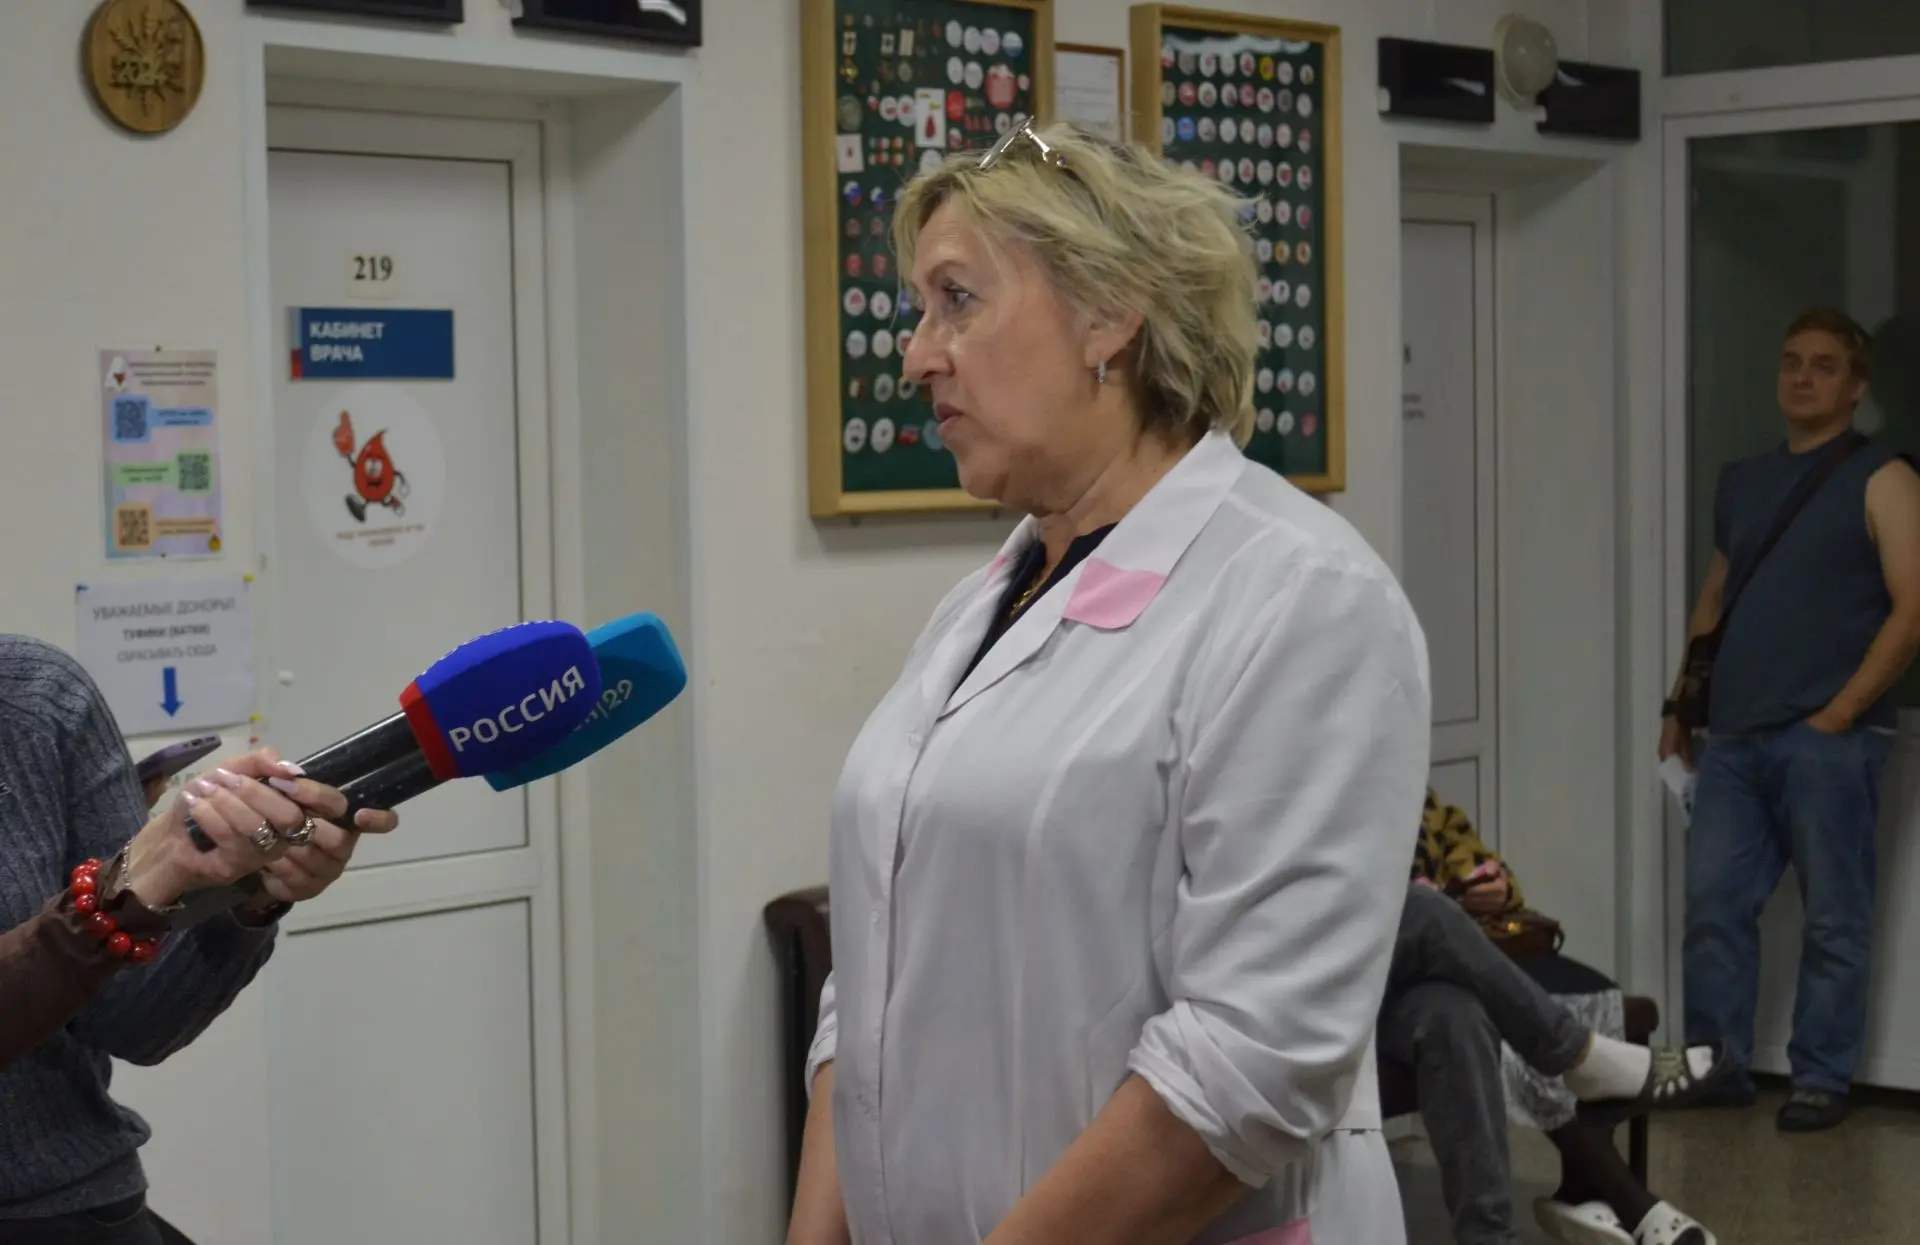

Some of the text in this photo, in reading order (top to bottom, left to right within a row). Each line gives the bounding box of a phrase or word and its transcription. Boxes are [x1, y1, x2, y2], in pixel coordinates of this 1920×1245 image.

[353, 256, 394, 281] 219
[309, 321, 385, 340] КАБИНЕТ
[309, 344, 364, 362] ВРАЧА
[93, 601, 173, 621] УВАЖАЕМЫЕ
[186, 644, 217, 657] СЮДА
[449, 665, 585, 752] РОССИЯ
